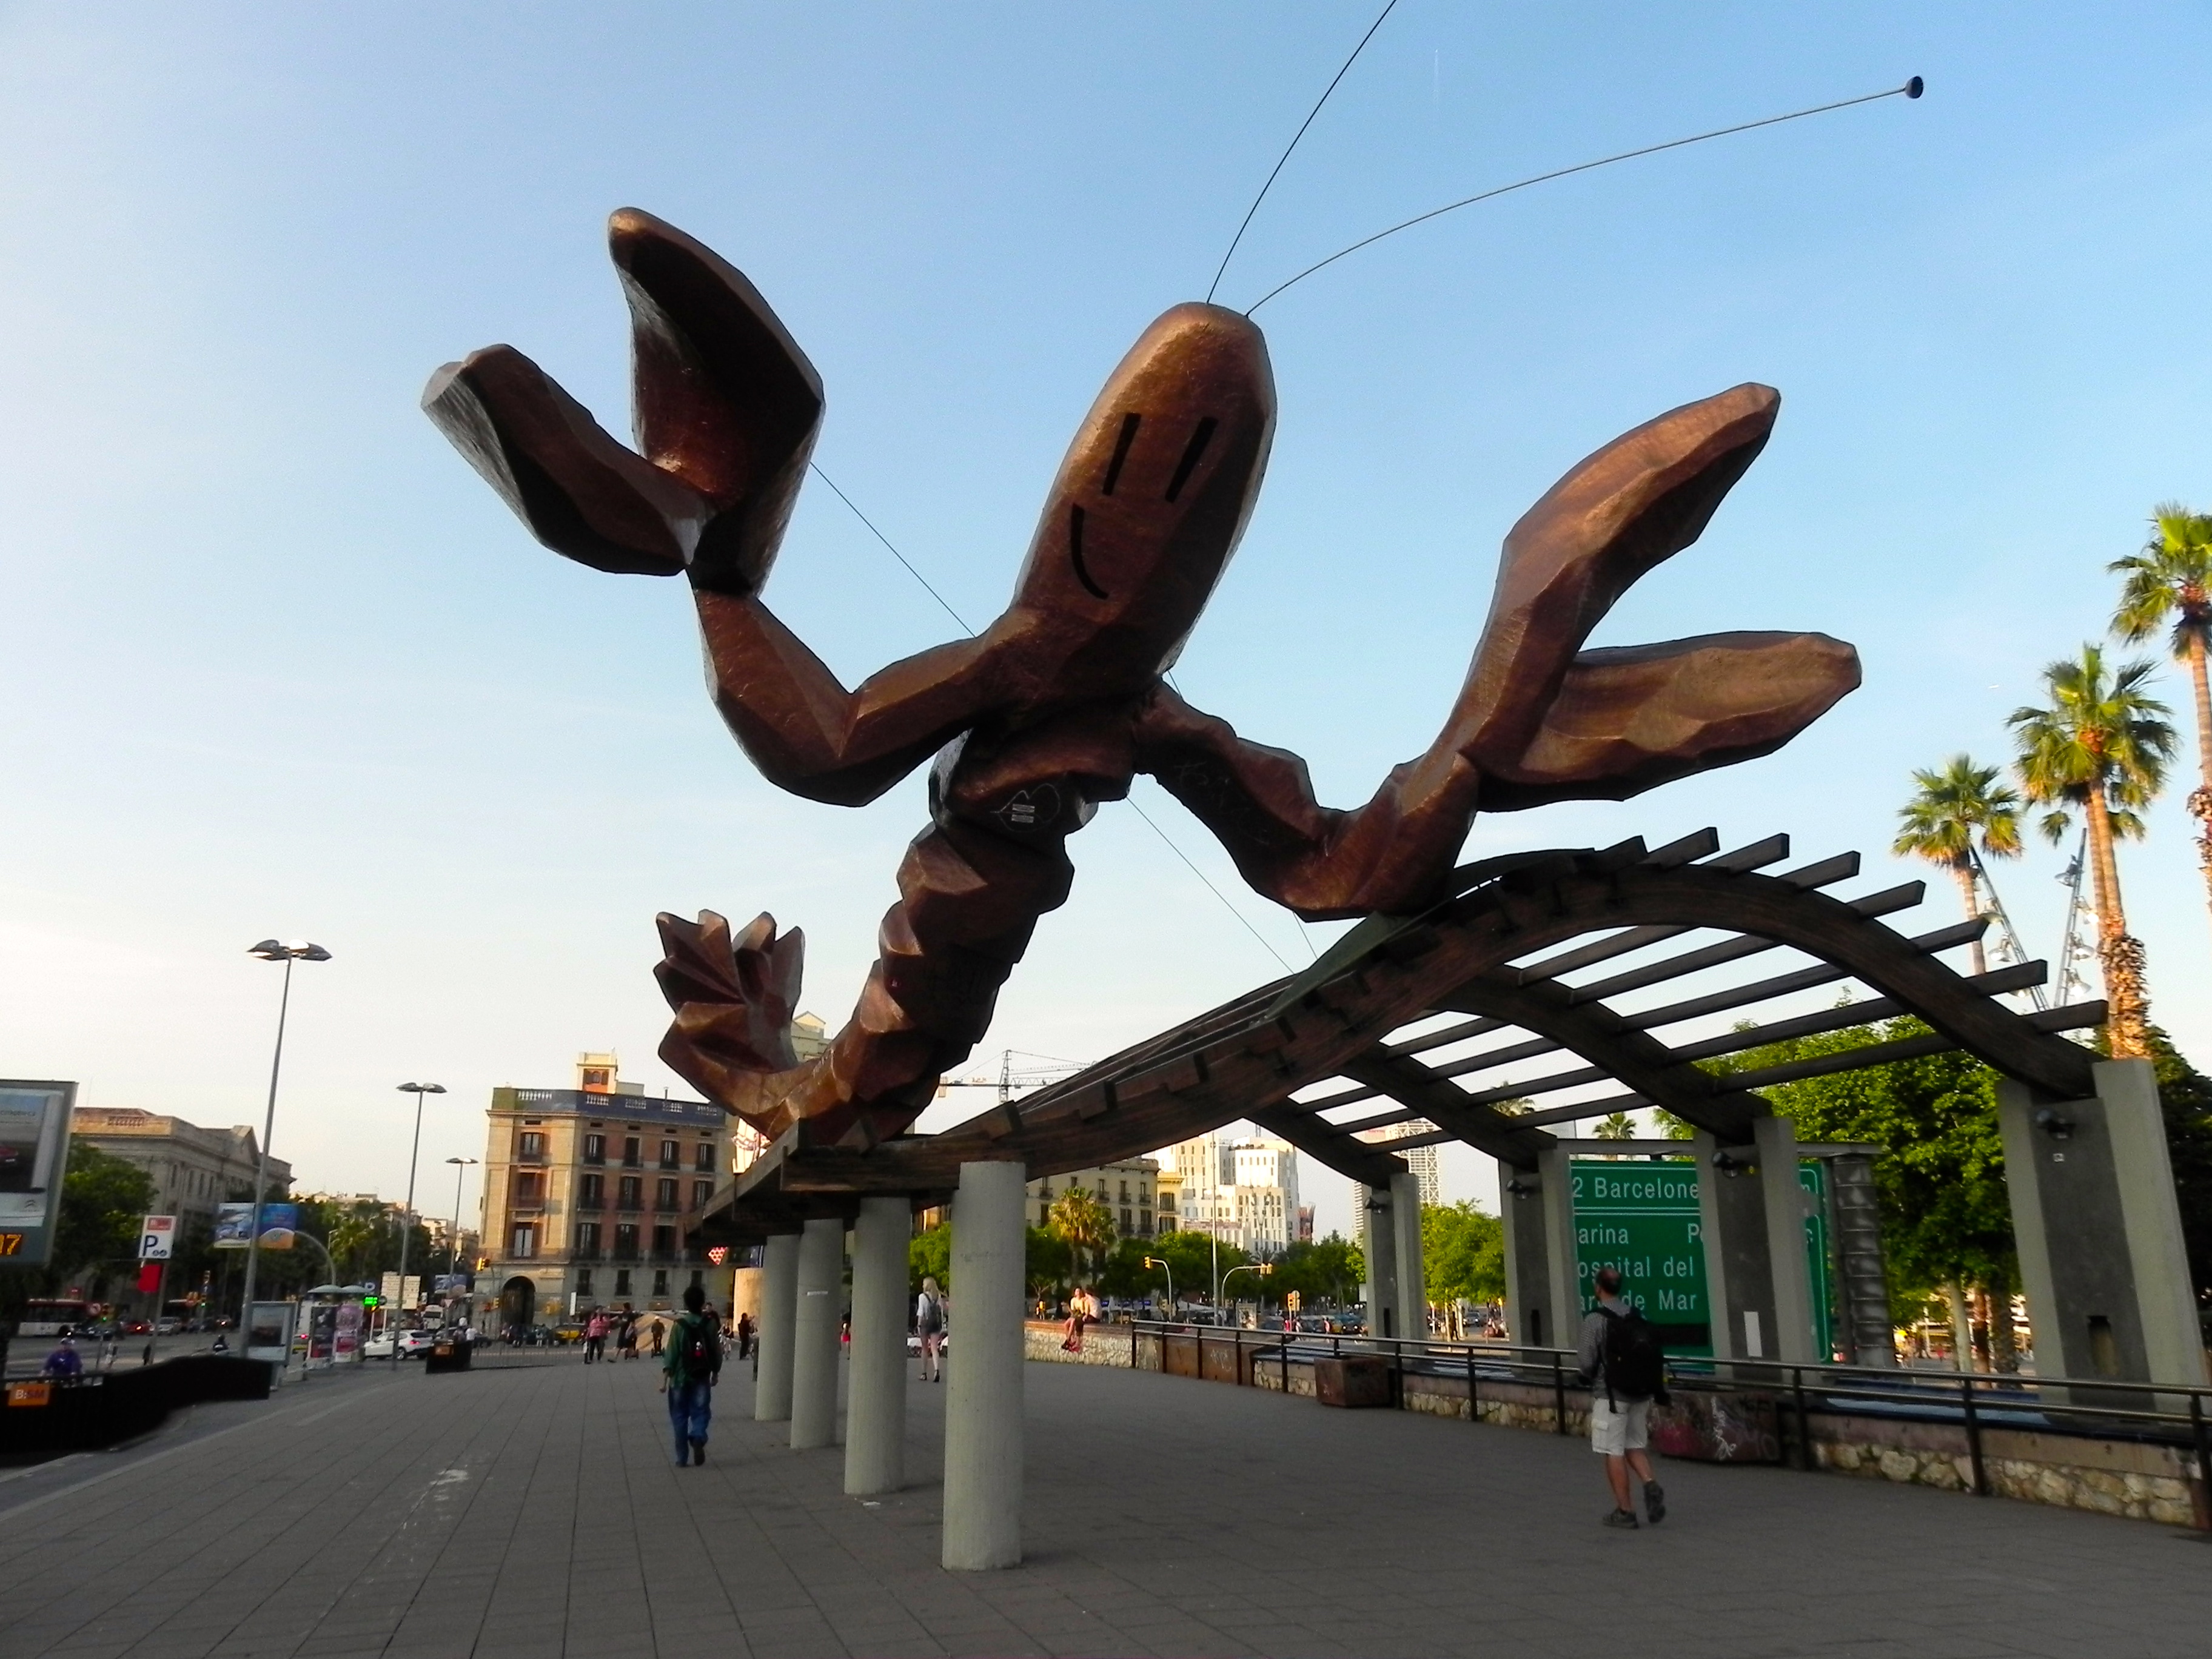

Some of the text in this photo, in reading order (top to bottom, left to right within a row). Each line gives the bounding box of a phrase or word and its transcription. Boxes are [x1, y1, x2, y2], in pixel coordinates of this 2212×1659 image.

[1578, 1223, 1629, 1244] arina
[142, 1235, 158, 1256] P
[1663, 1256, 1694, 1277] del
[1658, 1290, 1697, 1310] Mar
